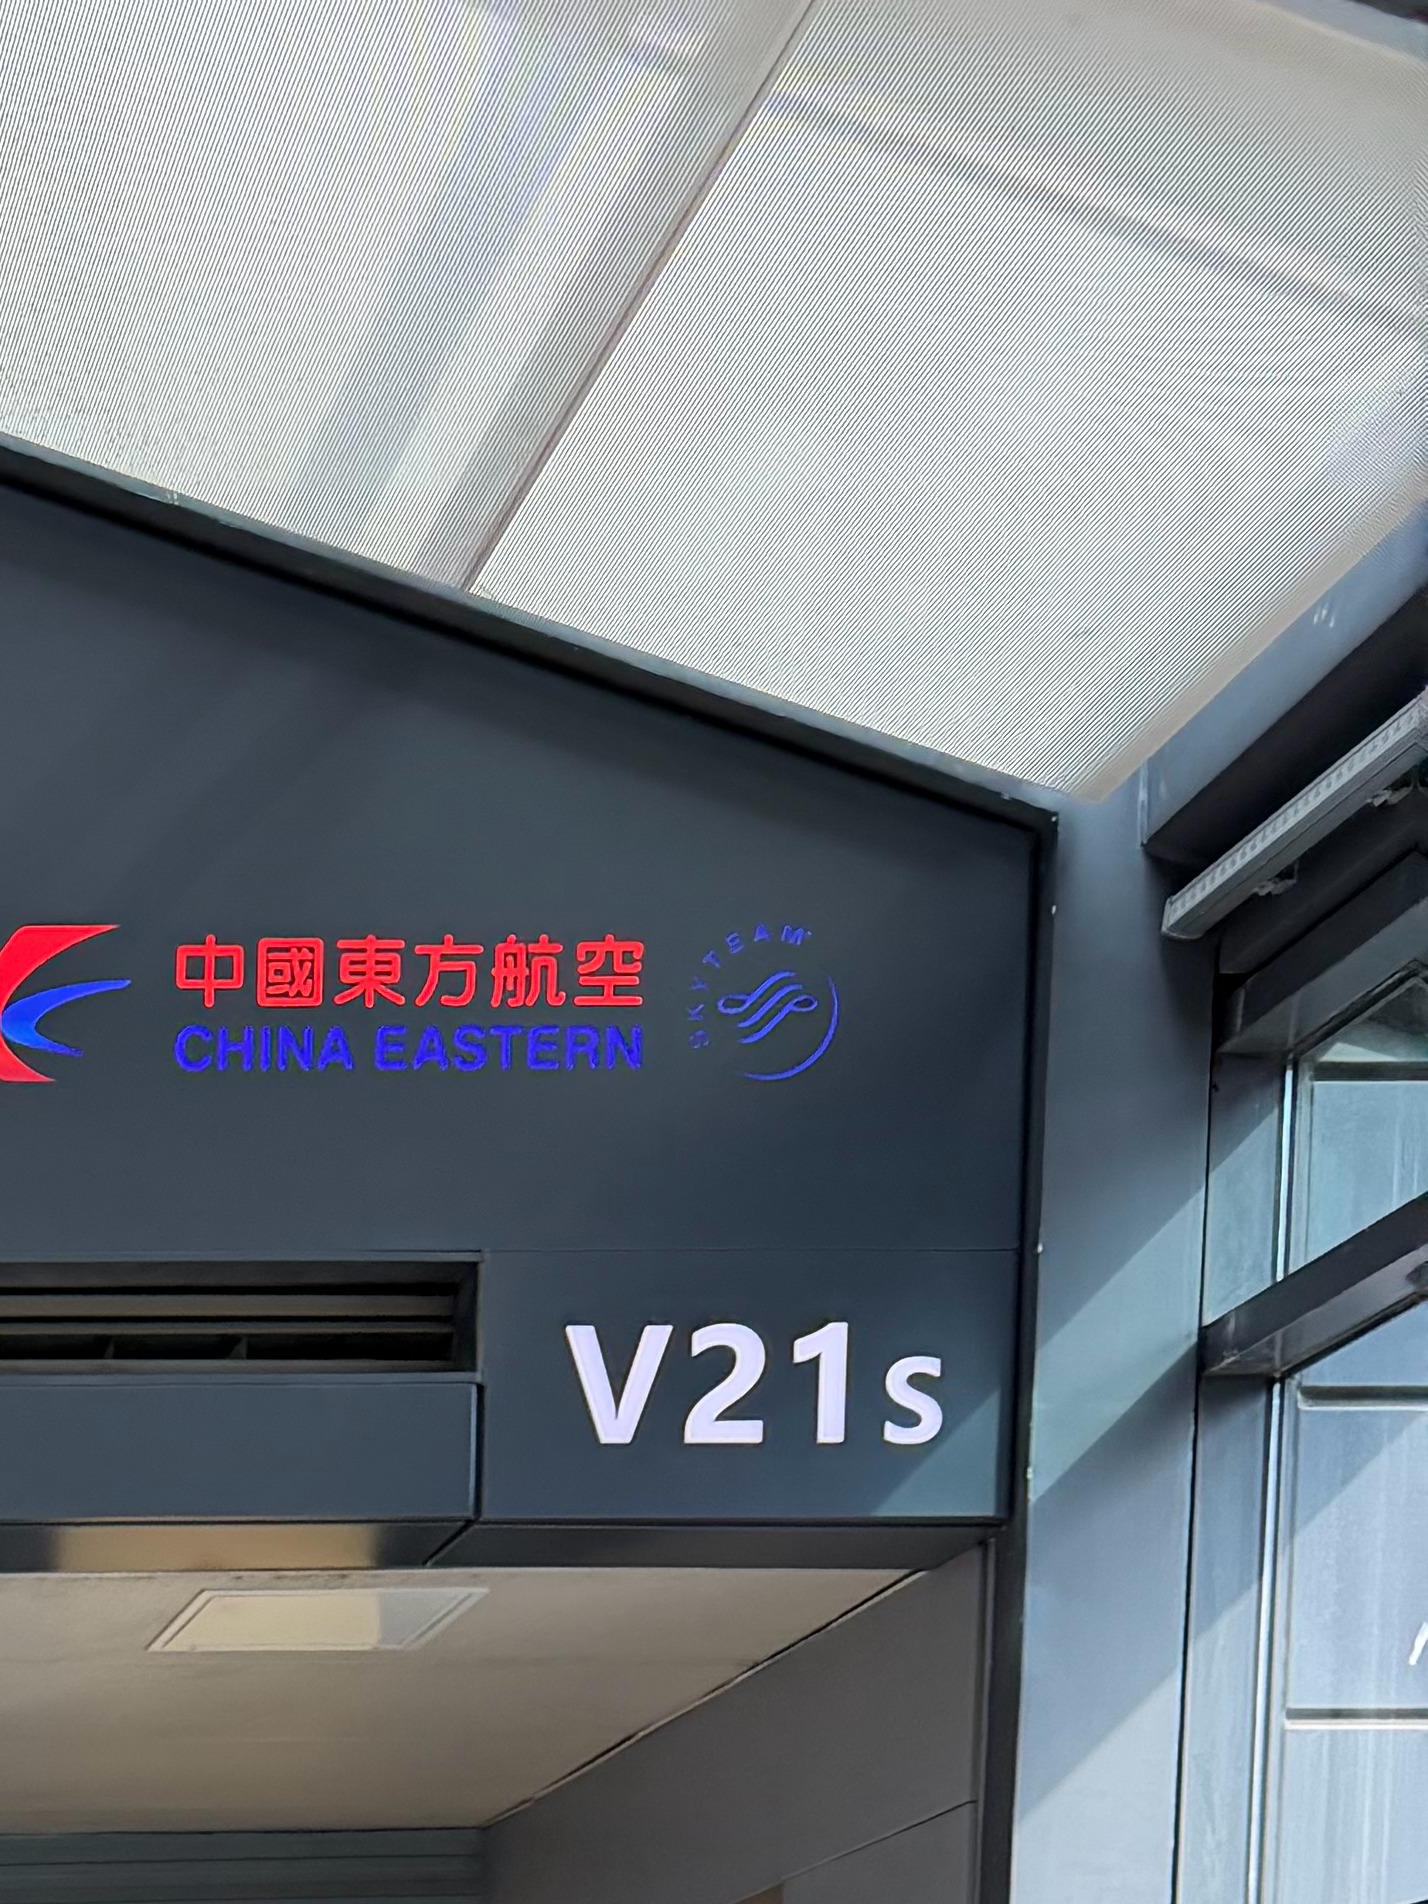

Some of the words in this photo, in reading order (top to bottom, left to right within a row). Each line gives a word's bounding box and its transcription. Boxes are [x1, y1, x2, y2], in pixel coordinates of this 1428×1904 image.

[172, 931, 646, 1011] 中國東方航空
[687, 921, 808, 1049] SKYTEAM
[171, 1022, 357, 1074] CHINA
[370, 1022, 645, 1074] EASTERN
